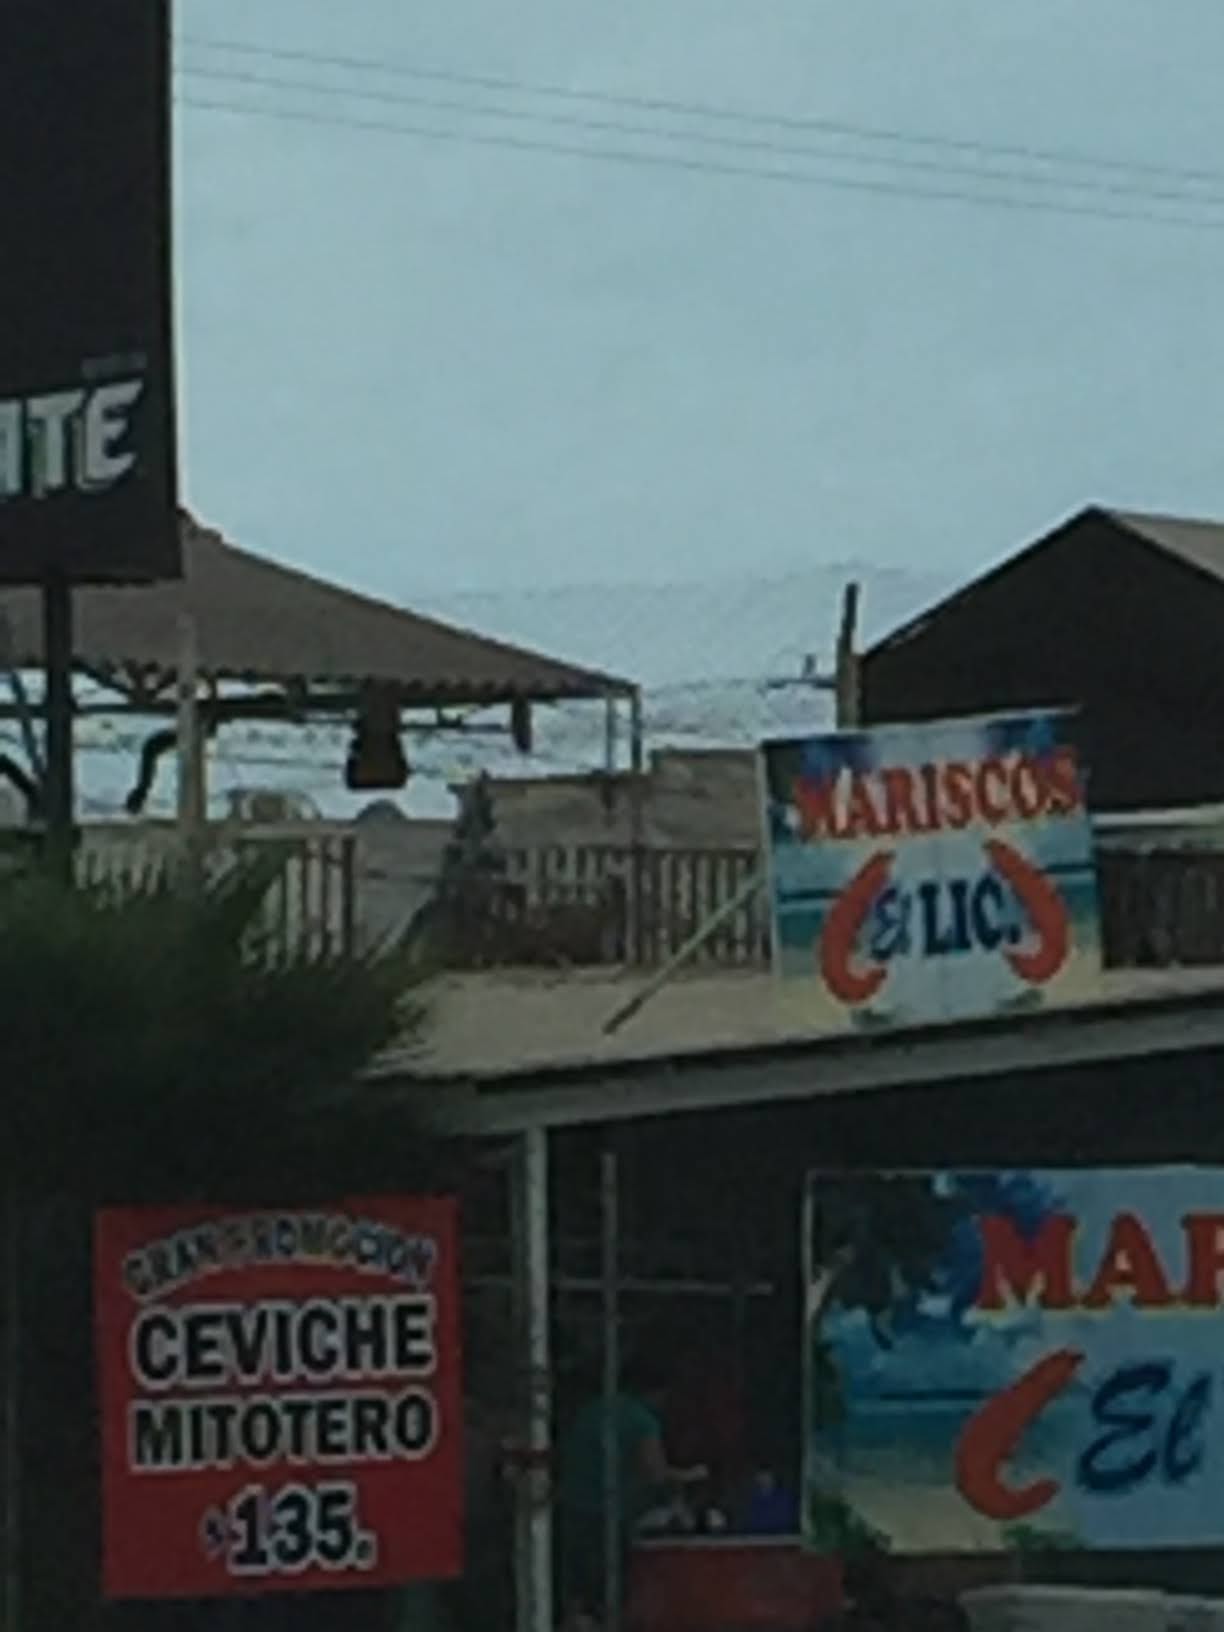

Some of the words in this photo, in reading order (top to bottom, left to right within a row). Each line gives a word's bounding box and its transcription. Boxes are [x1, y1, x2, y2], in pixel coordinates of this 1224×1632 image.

[793, 749, 1081, 842] MARISCOS
[916, 871, 1022, 957] LIC.
[132, 1297, 437, 1388] CEVICHE
[130, 1390, 438, 1472] MITOTERO
[1077, 1356, 1212, 1496] El
